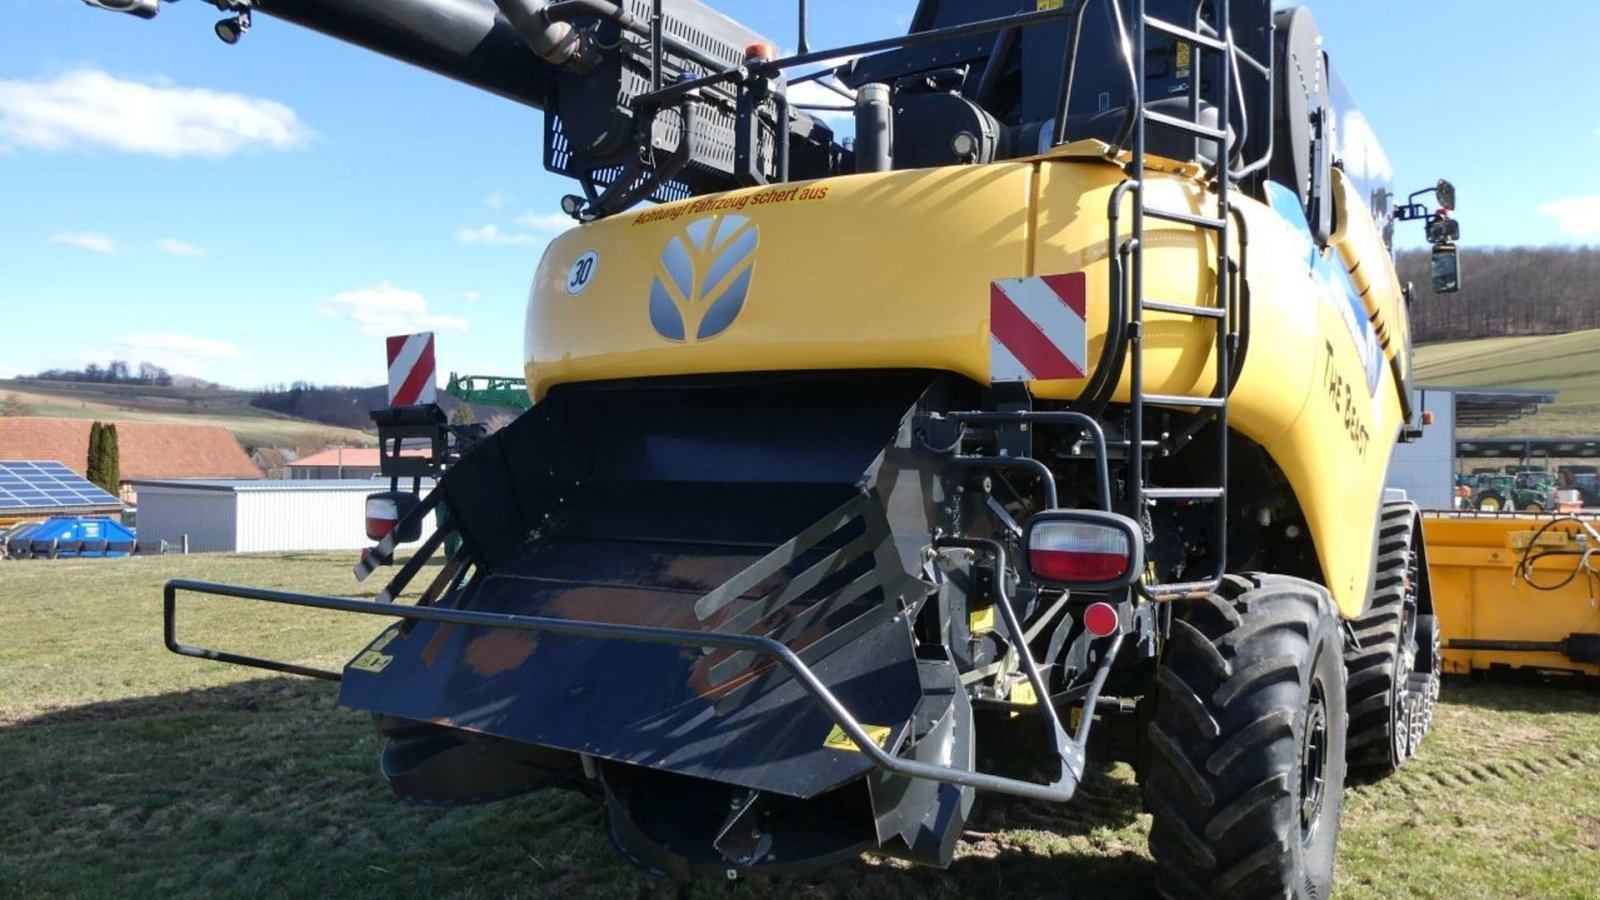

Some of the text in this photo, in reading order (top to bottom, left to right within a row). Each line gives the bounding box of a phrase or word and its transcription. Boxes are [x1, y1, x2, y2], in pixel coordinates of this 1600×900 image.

[632, 186, 829, 226] Achtung! Fahrzeug schert aus
[570, 257, 593, 287] 30
[1323, 338, 1370, 463] THE BEAST
